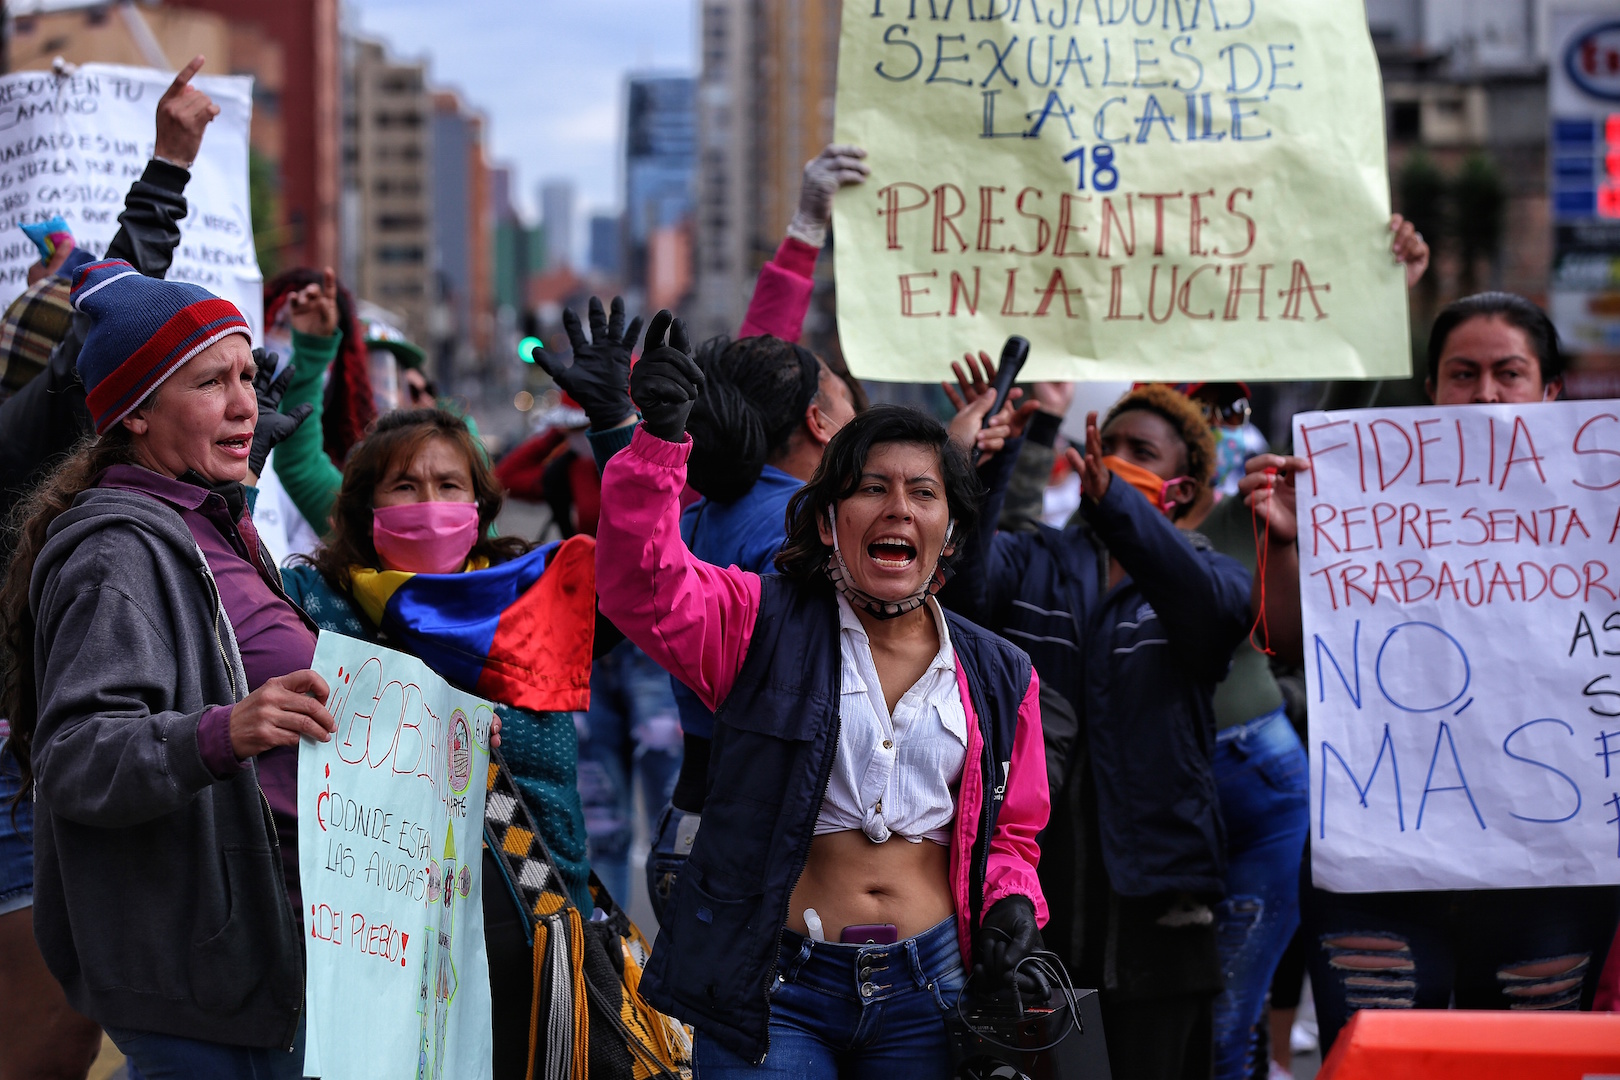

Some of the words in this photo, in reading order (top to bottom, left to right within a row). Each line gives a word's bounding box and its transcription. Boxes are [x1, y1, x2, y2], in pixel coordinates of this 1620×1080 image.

[874, 23, 1205, 94] SEXUALES
[1219, 42, 1303, 94] DE
[106, 78, 145, 102] TU
[978, 89, 1080, 140] LA
[1093, 93, 1272, 144] CALLE
[1062, 145, 1119, 192] 18
[876, 181, 1256, 259] PRESENTES
[898, 265, 981, 318] EN
[1000, 266, 1082, 318] LA
[1103, 259, 1331, 324] LUCHA
[1299, 415, 1547, 497] FIDELIA
[1310, 502, 1591, 557] REPRESENTA
[1310, 558, 1620, 610] TRABAJADOR
[325, 838, 356, 879] LAS
